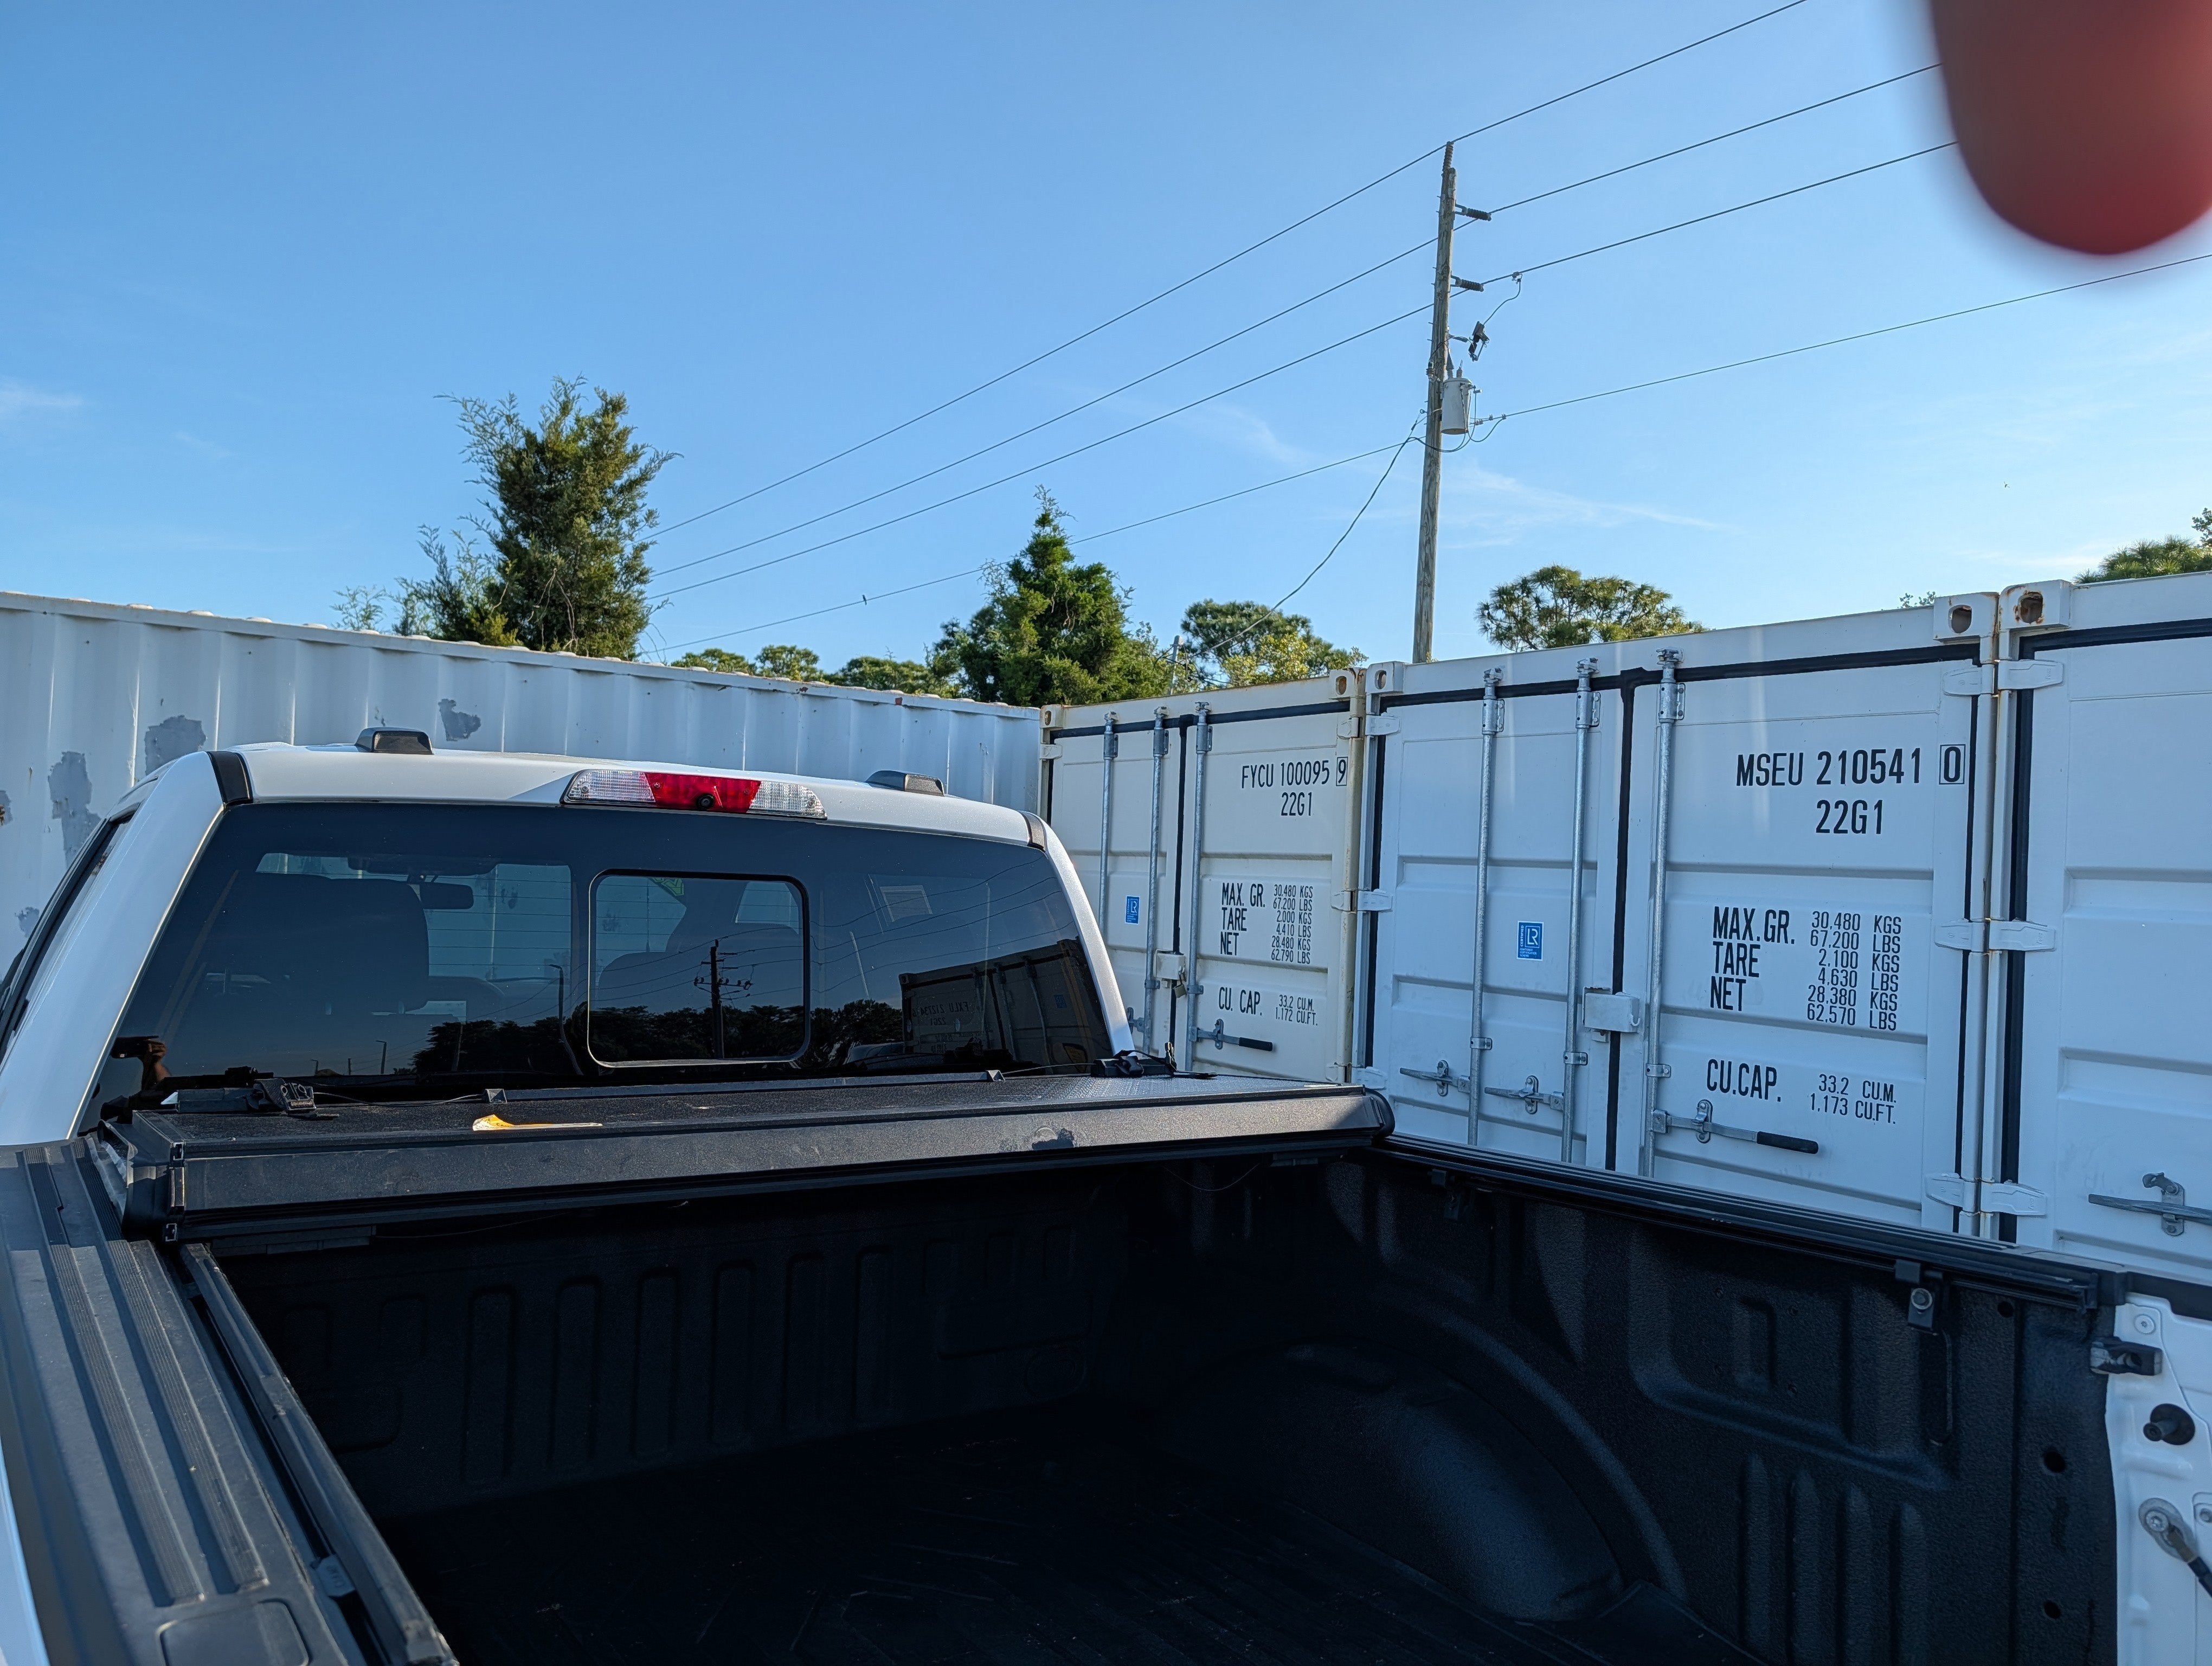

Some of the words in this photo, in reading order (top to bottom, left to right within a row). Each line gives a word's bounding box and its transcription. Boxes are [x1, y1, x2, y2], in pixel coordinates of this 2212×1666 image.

[1242, 763, 1274, 789] FYCU
[1280, 760, 1330, 786] 100095
[1338, 759, 1347, 784] 9
[1736, 752, 1804, 786] MSEU
[1816, 747, 1920, 785] 210541
[1943, 746, 1962, 783] 0
[1281, 791, 1313, 816] 22G1
[1815, 799, 1883, 835] 22G1
[1221, 882, 1244, 906] MAX.
[1250, 883, 1265, 908] GR.
[1300, 885, 1313, 899] KGS
[1299, 898, 1312, 912] LBS
[1221, 907, 1248, 932] TARE
[1298, 911, 1312, 925] KGS
[1811, 911, 1861, 931] 30,480
[1873, 914, 1901, 934] KGS
[1220, 931, 1239, 956] NET
[1298, 925, 1311, 938] LBS
[1527, 928, 1538, 945] LR
[1810, 929, 1859, 950] 67,200
[1873, 934, 1900, 954] LBS
[1297, 938, 1311, 951] KGS
[1297, 951, 1310, 964] LBS
[1712, 940, 1761, 978] TARE
[1818, 948, 1859, 969] 2,100
[1872, 953, 1900, 973] KGS
[1818, 967, 1857, 988] 4,630
[1871, 972, 1899, 992] LBS
[1219, 986, 1233, 1011] CU.
[1239, 989, 1263, 1016] CAP.
[1278, 994, 1294, 1009] 33.2
[1710, 975, 1747, 1011] NET
[1808, 984, 1856, 1007] 28,380
[1870, 991, 1898, 1012] KGS
[1296, 1010, 1318, 1026] CU.FT.
[1807, 1002, 1856, 1026] 62,570
[1869, 1010, 1896, 1031] LBS
[1818, 1073, 1849, 1095] 33.2
[1862, 1080, 1896, 1104] CU.M.
[1810, 1092, 1848, 1116] 1,173
[1855, 1100, 1896, 1125] CU.FT.
